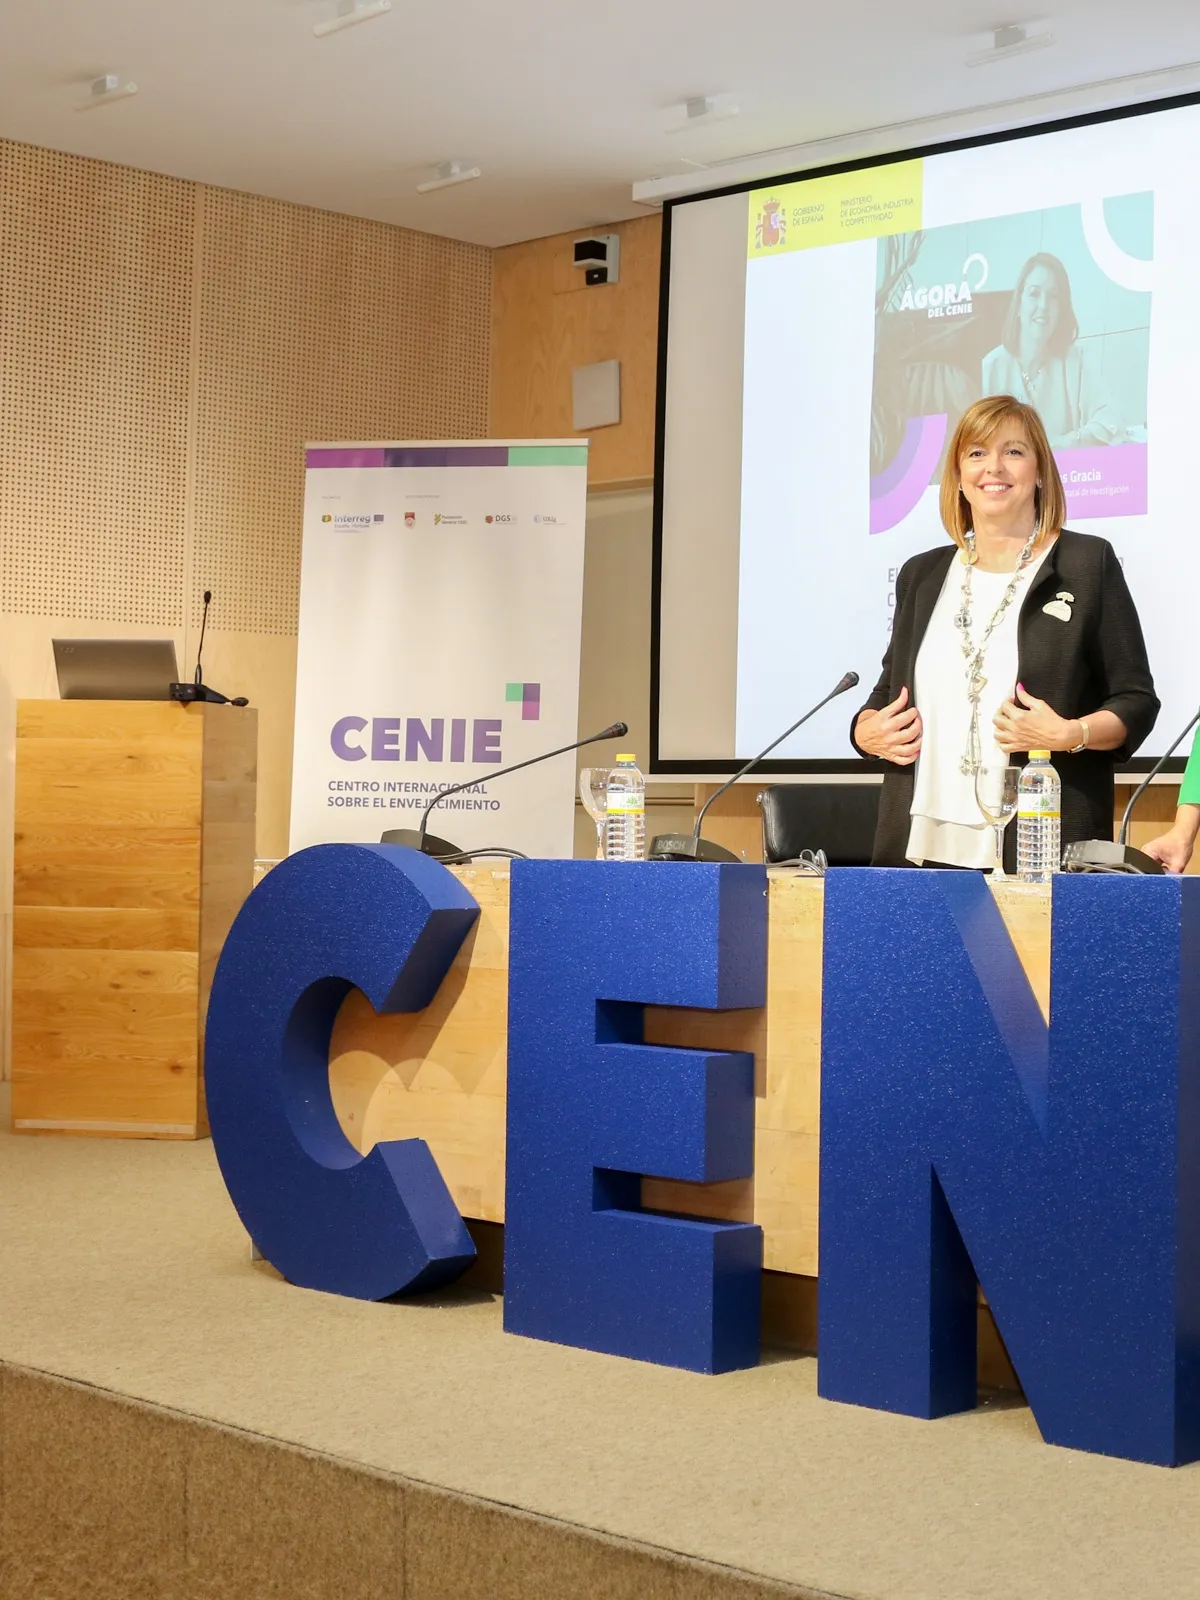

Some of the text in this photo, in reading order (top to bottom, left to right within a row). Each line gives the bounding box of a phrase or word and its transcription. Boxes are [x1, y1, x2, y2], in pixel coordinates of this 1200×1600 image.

[793, 204, 825, 217] GOBIERNO
[900, 281, 972, 311] ÁGORA
[928, 302, 972, 319] DEL CENIE
[1070, 468, 1102, 483] Gracia
[334, 515, 371, 524] Interreg
[330, 715, 502, 763] CENIE
[328, 780, 488, 795] CENTRO INTERNACIONAL
[327, 796, 369, 808] SOBRE
[373, 797, 387, 808] EL
